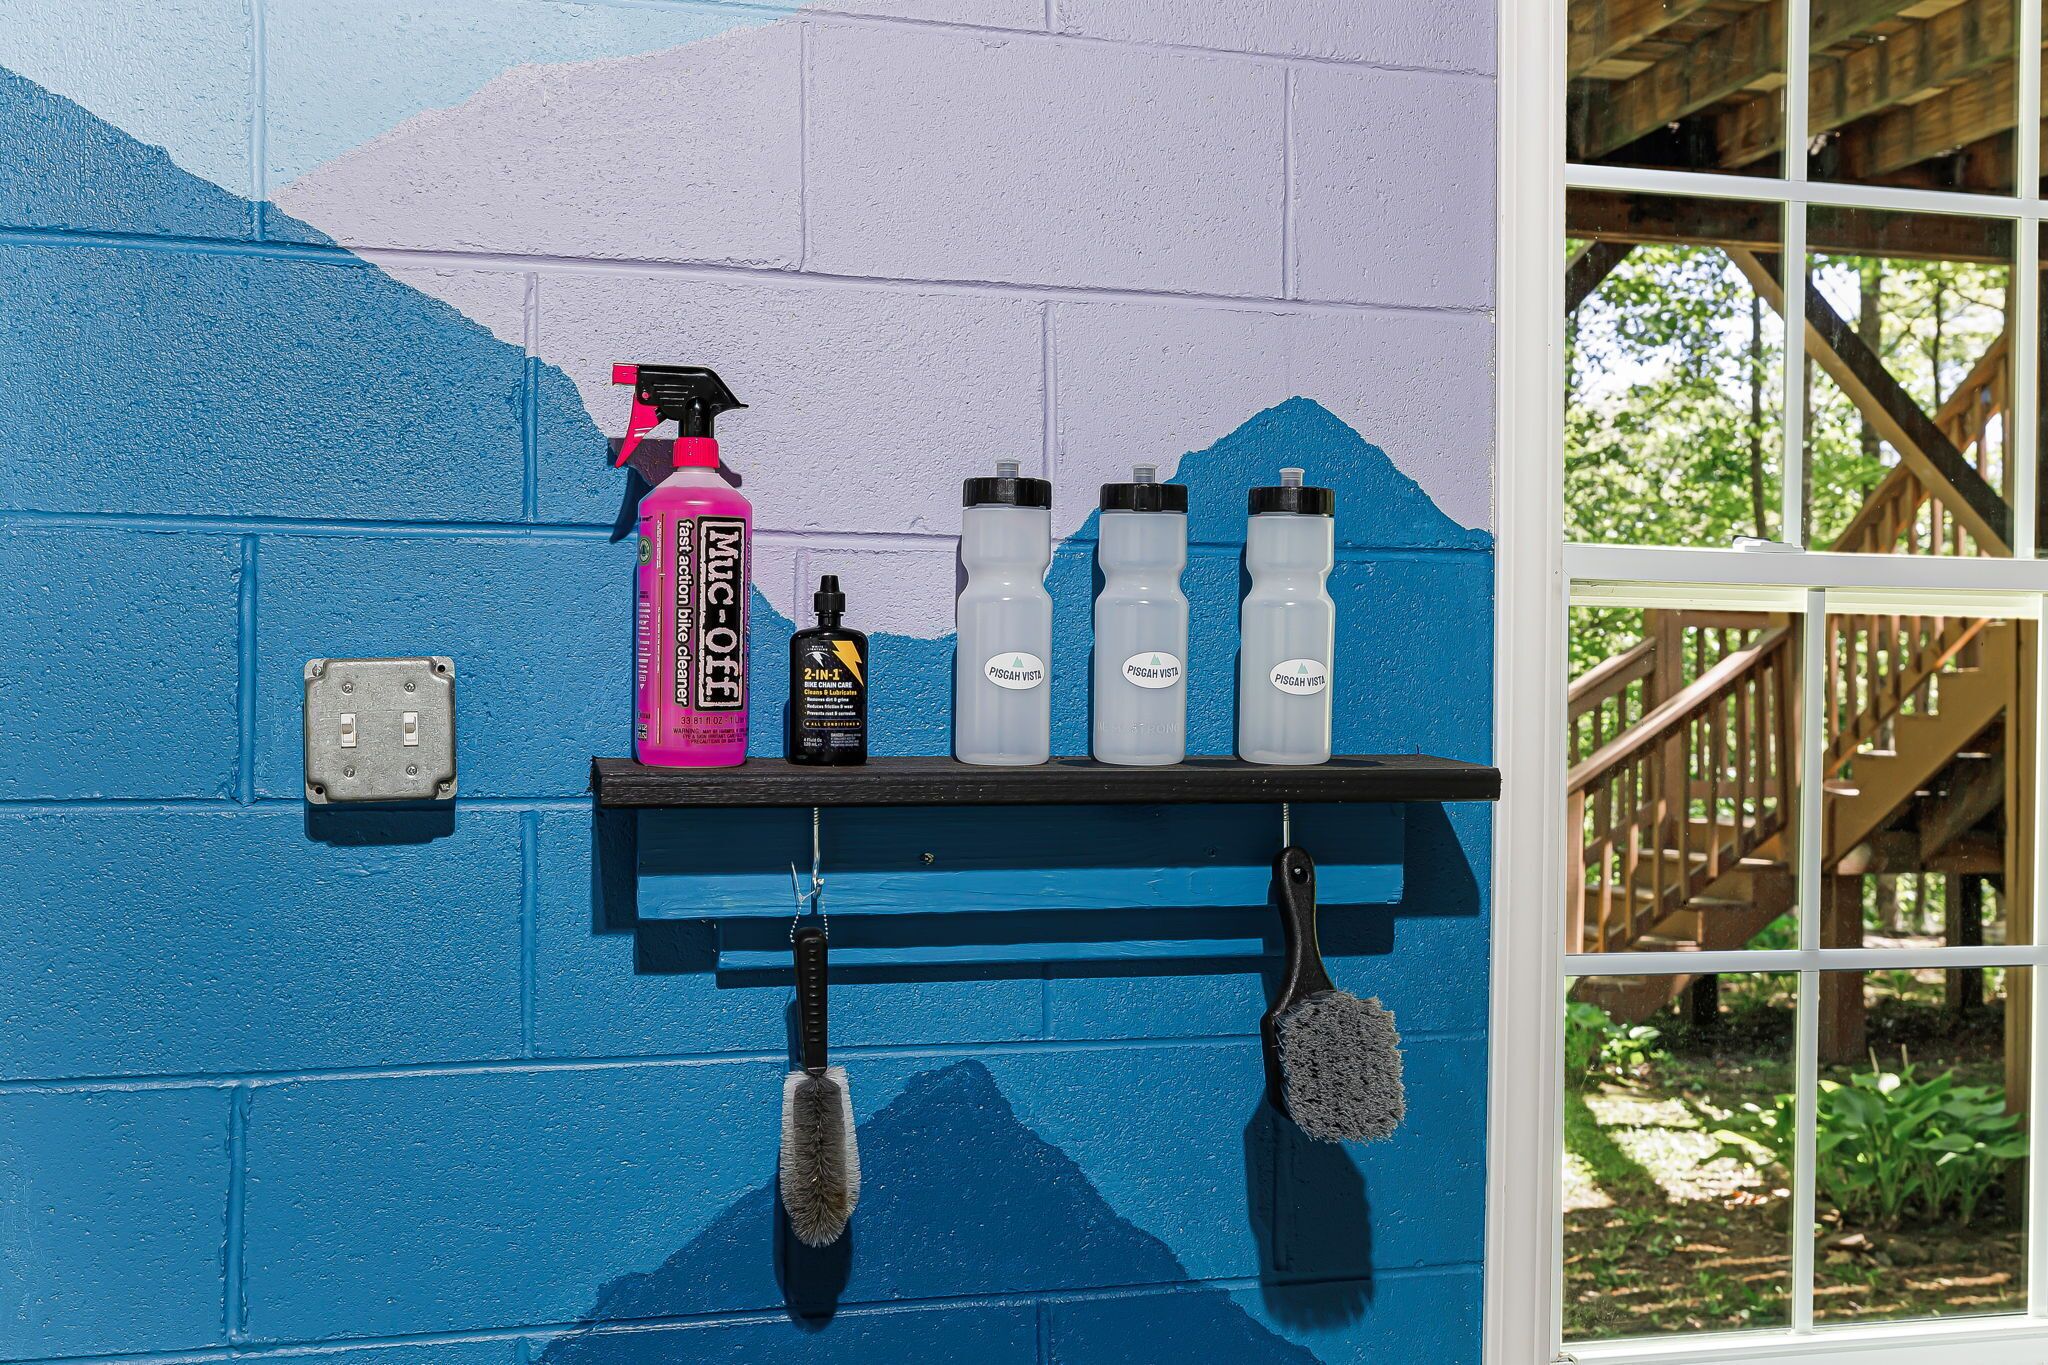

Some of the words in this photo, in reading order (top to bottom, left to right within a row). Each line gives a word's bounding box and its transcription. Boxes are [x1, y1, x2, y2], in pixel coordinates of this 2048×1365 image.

[679, 520, 693, 552] fast
[678, 555, 692, 605] action
[677, 608, 692, 642] bike
[676, 646, 691, 705] cleaner
[989, 666, 1021, 681] PISGAH
[1022, 669, 1042, 681] VISTA
[1127, 664, 1158, 678] PISGAH
[1159, 667, 1178, 678] VISTA
[1274, 673, 1305, 687] PISGAH
[1306, 675, 1325, 687] VISTA
